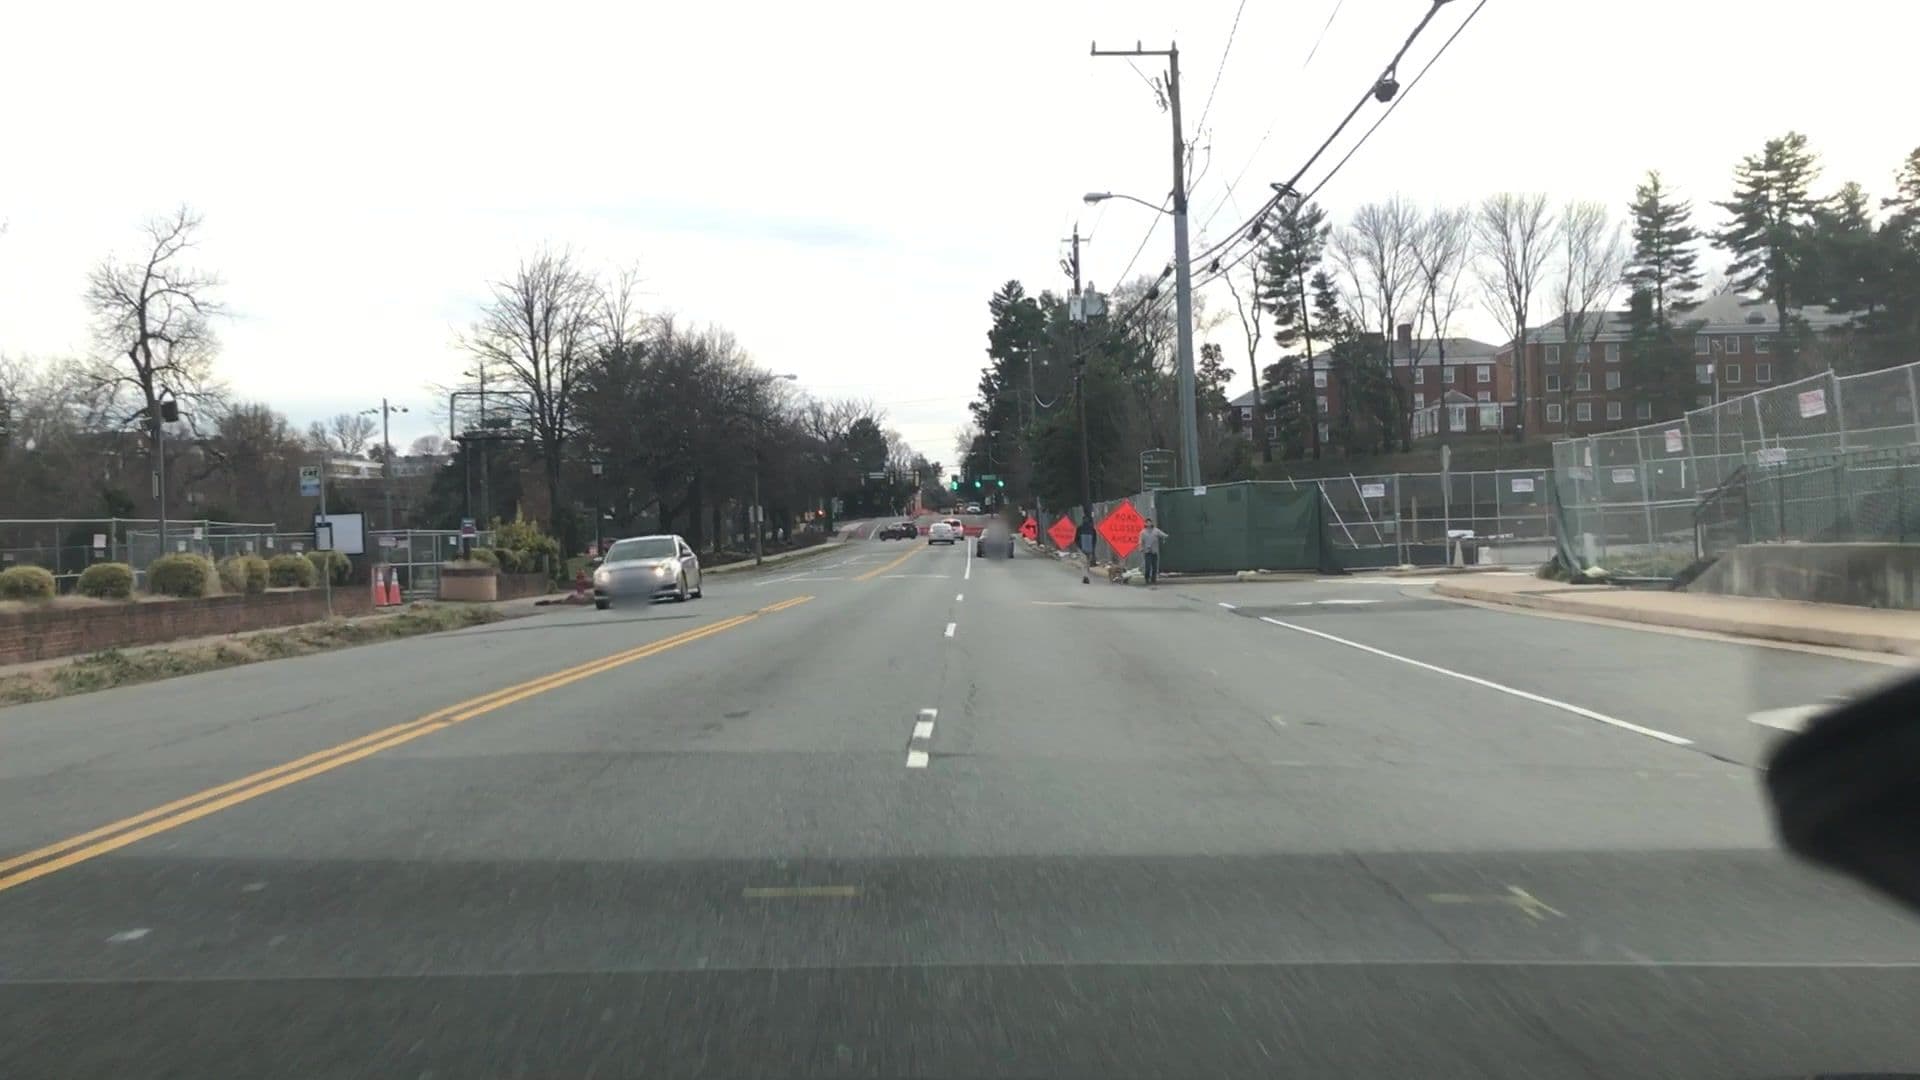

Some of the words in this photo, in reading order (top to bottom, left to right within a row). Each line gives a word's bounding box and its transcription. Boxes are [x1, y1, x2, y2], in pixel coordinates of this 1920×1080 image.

[1115, 512, 1138, 521] ROAD
[1110, 525, 1141, 533] CLOSED
[1111, 535, 1139, 543] AHEAD
